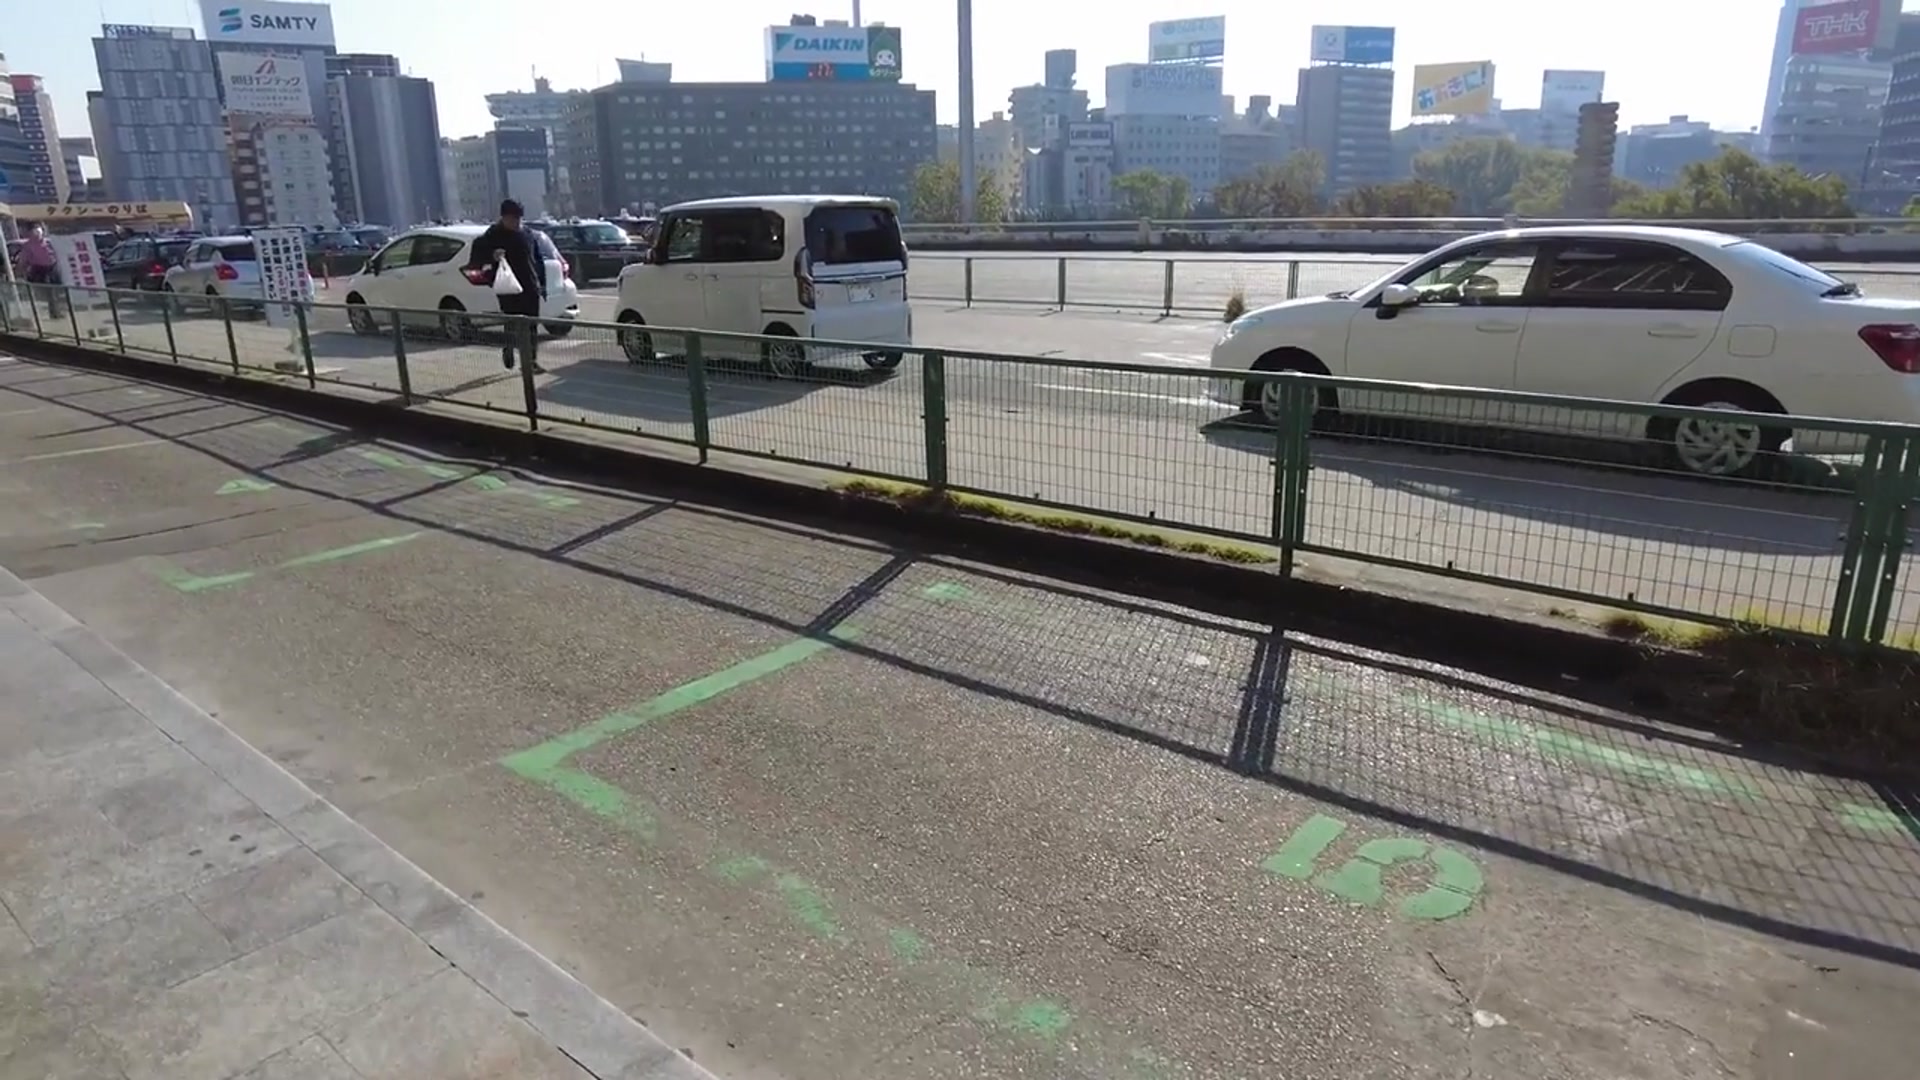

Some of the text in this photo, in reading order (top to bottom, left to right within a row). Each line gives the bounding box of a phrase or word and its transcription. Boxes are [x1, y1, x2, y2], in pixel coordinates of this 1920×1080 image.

[251, 14, 318, 31] SAMTY
[1804, 10, 1869, 36] THK
[793, 38, 865, 51] DAIKIN
[46, 204, 148, 216] タクシーのりば
